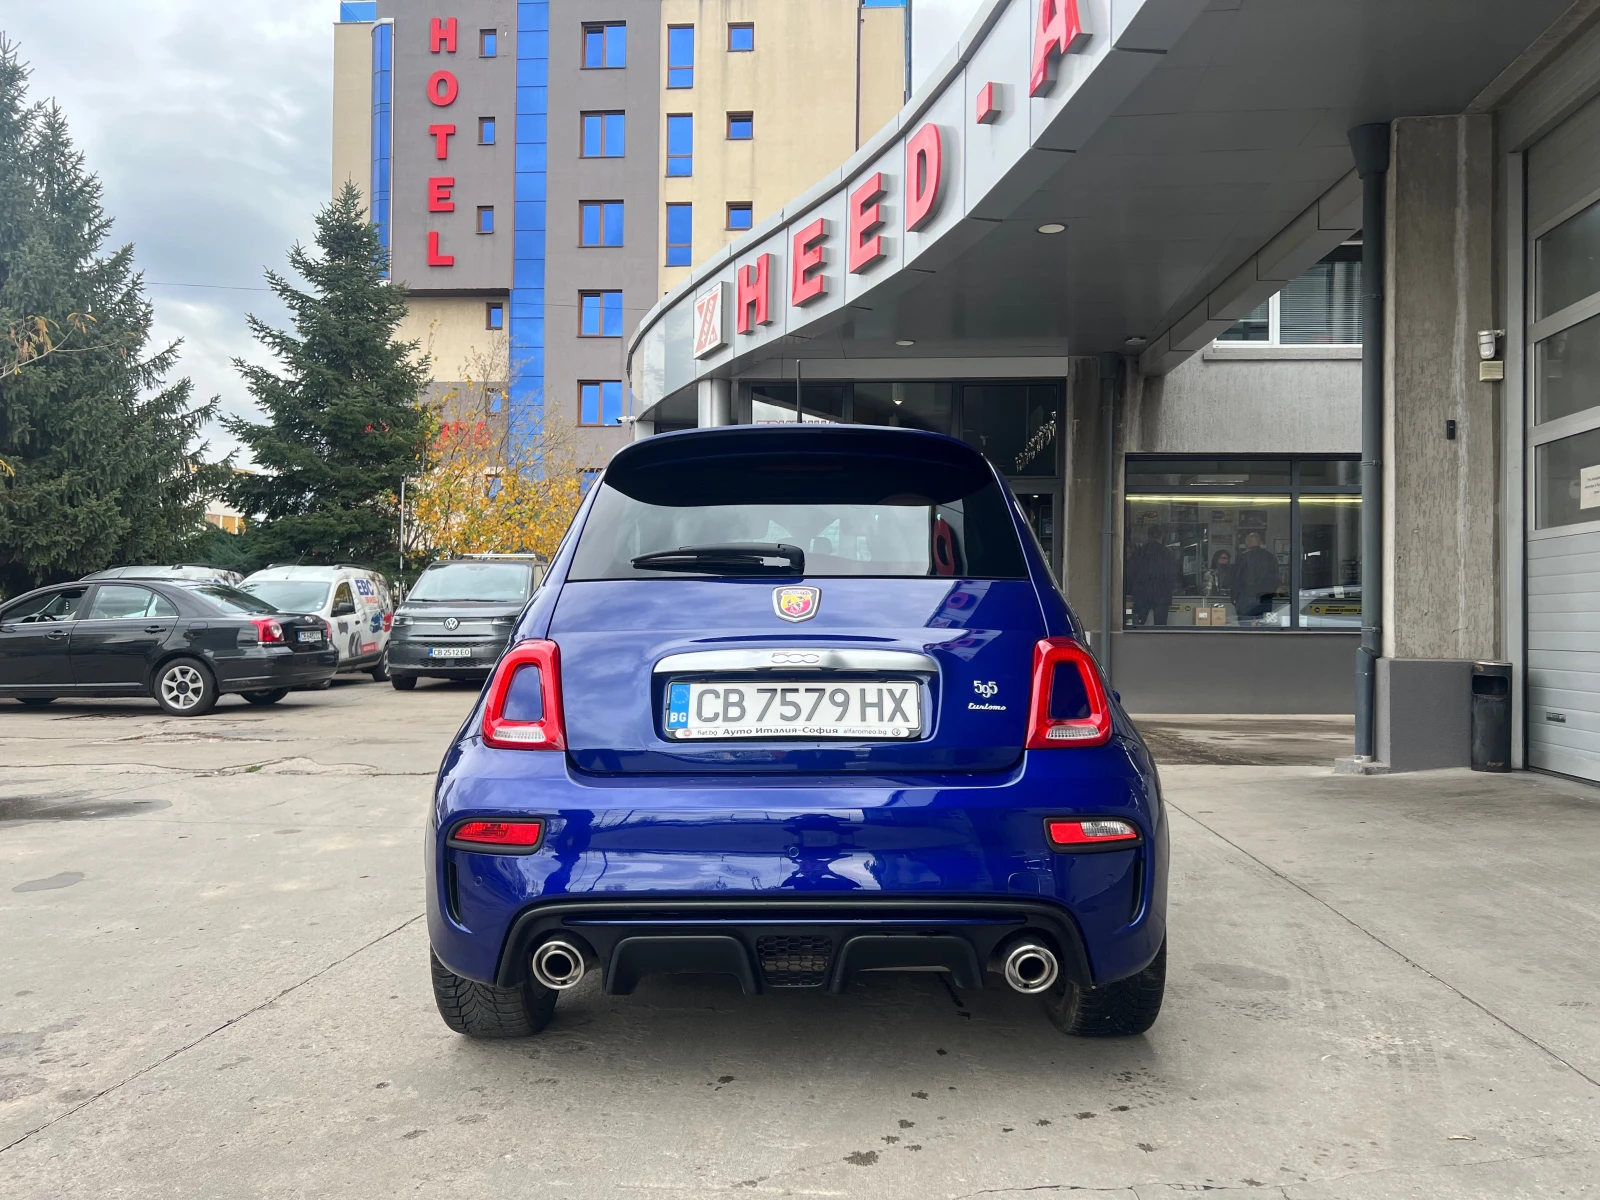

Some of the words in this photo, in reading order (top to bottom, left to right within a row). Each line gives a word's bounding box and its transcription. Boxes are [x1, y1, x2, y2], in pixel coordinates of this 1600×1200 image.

[427, 17, 458, 266] HOTEL
[355, 579, 375, 596] EBC
[973, 680, 998, 698] 595
[696, 688, 746, 722] CB
[756, 688, 850, 722] 7579
[860, 688, 910, 722] HX
[669, 712, 687, 722] BG
[843, 728, 887, 736] alfaromeo.bg
